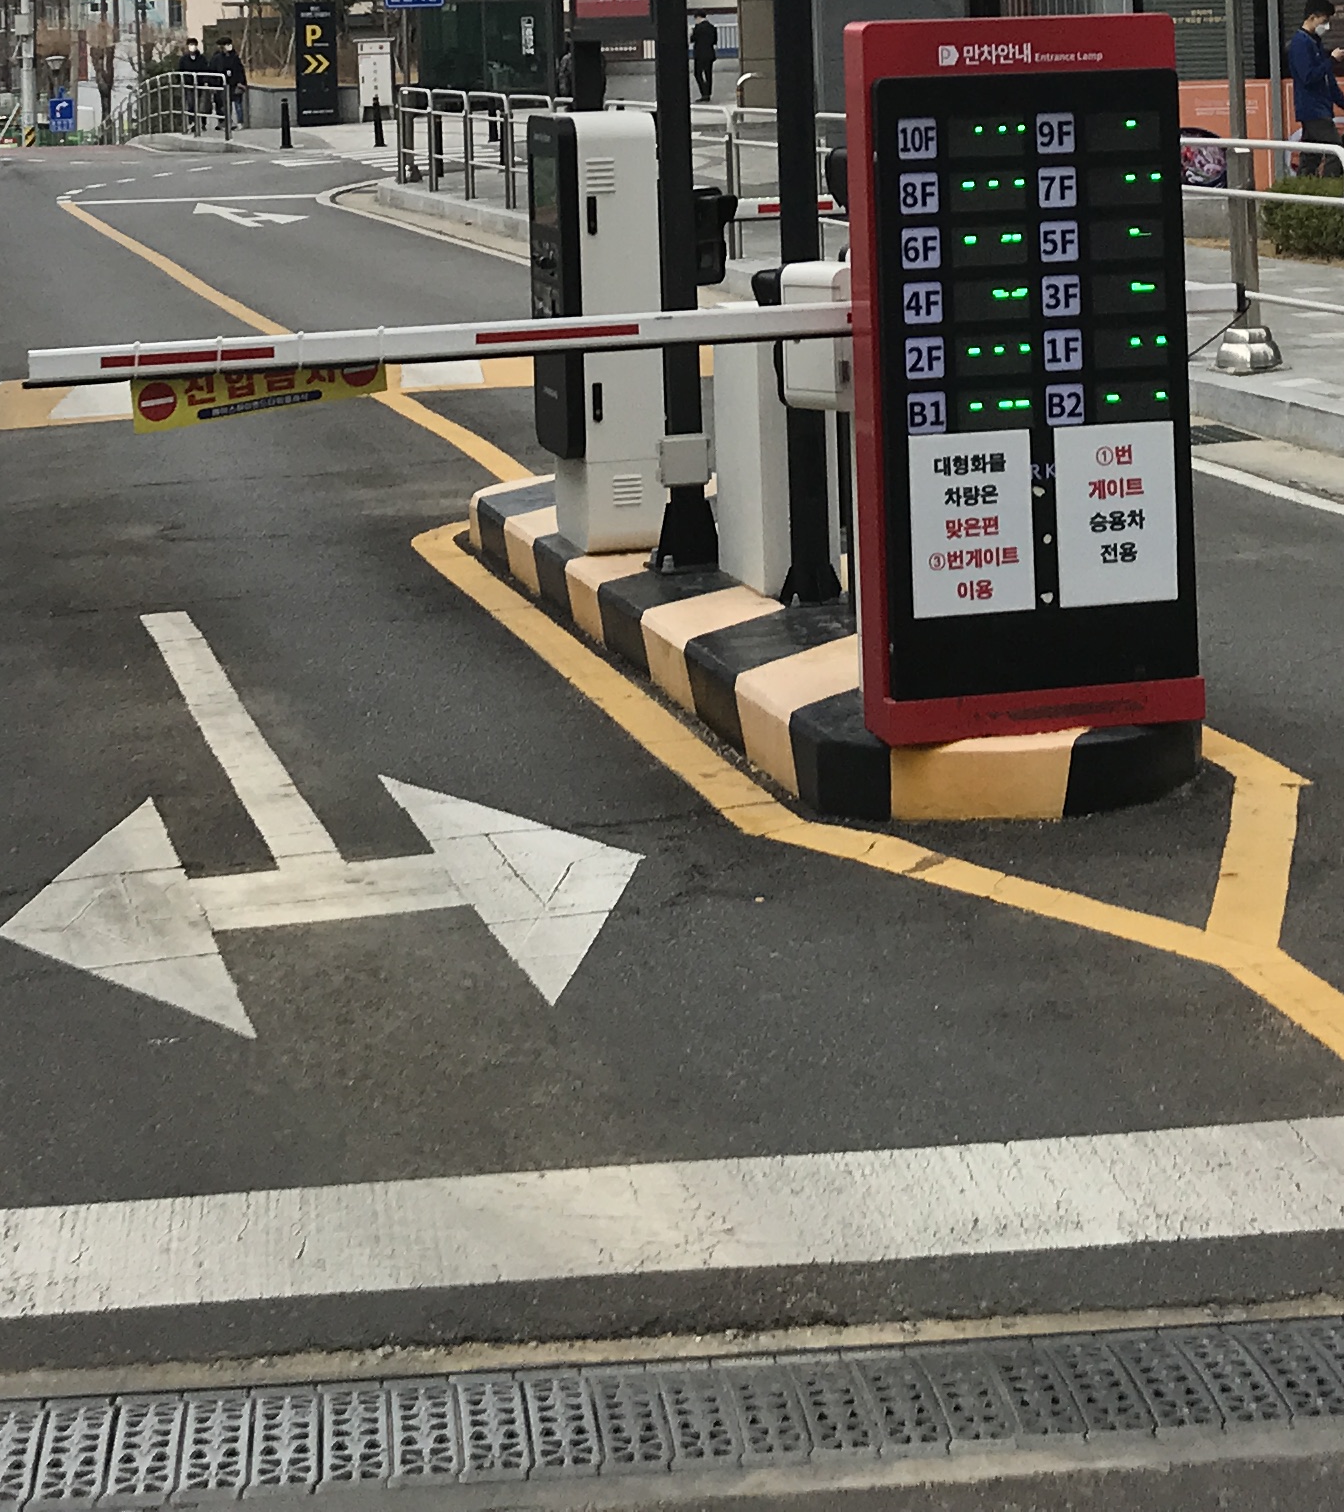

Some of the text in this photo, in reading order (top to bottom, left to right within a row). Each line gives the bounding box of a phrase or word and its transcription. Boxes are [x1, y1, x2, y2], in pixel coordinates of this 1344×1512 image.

[963, 42, 1032, 65] 만차안내
[1035, 53, 1075, 63] Entrance
[1077, 52, 1103, 63] Lamp
[899, 126, 936, 152] 10F
[1038, 120, 1073, 147] 9F
[901, 181, 936, 208] 8F
[1040, 175, 1074, 202] 7F
[903, 236, 938, 263] 6F
[1041, 229, 1076, 256] 5F
[905, 290, 940, 317] 4F
[1044, 283, 1078, 310] 3F
[907, 345, 942, 372] 2F
[1046, 338, 1079, 364] 1F
[909, 399, 945, 427] B1
[1047, 392, 1082, 419] B2
[933, 453, 1006, 476] 대형화물
[944, 484, 999, 508] 차량은
[1088, 476, 1145, 500] 게이트
[945, 515, 1000, 539] 맞은편
[1089, 509, 1146, 533] 승용차
[1100, 542, 1138, 565] 전용
[957, 579, 994, 600] 이용
